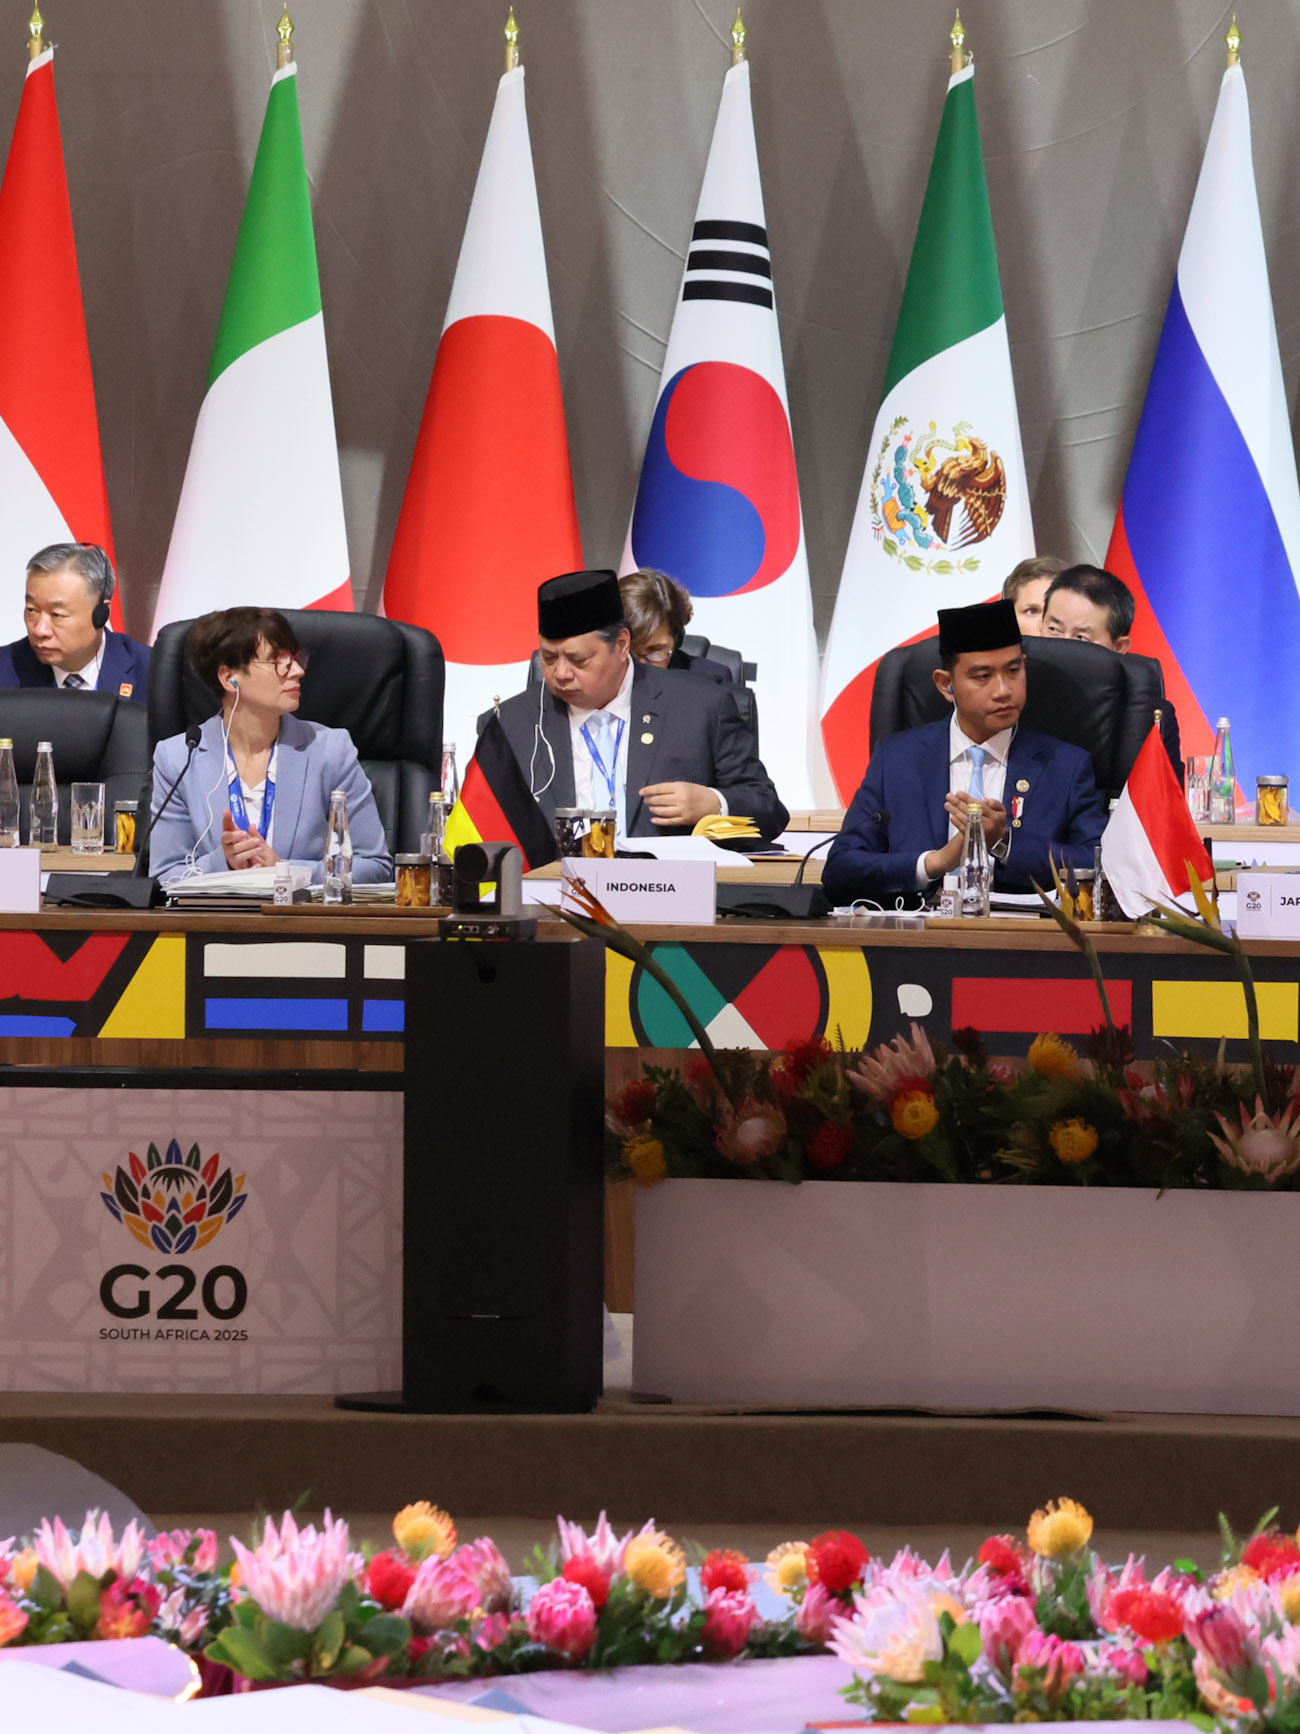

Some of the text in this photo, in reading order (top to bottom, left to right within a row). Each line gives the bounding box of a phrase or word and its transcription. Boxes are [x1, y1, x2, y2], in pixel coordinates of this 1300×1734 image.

[606, 882, 676, 893] INDONESIA
[1246, 902, 1262, 910] G20
[99, 1263, 248, 1320] G20
[99, 1328, 249, 1342] SOUTH AFRICA 2025
